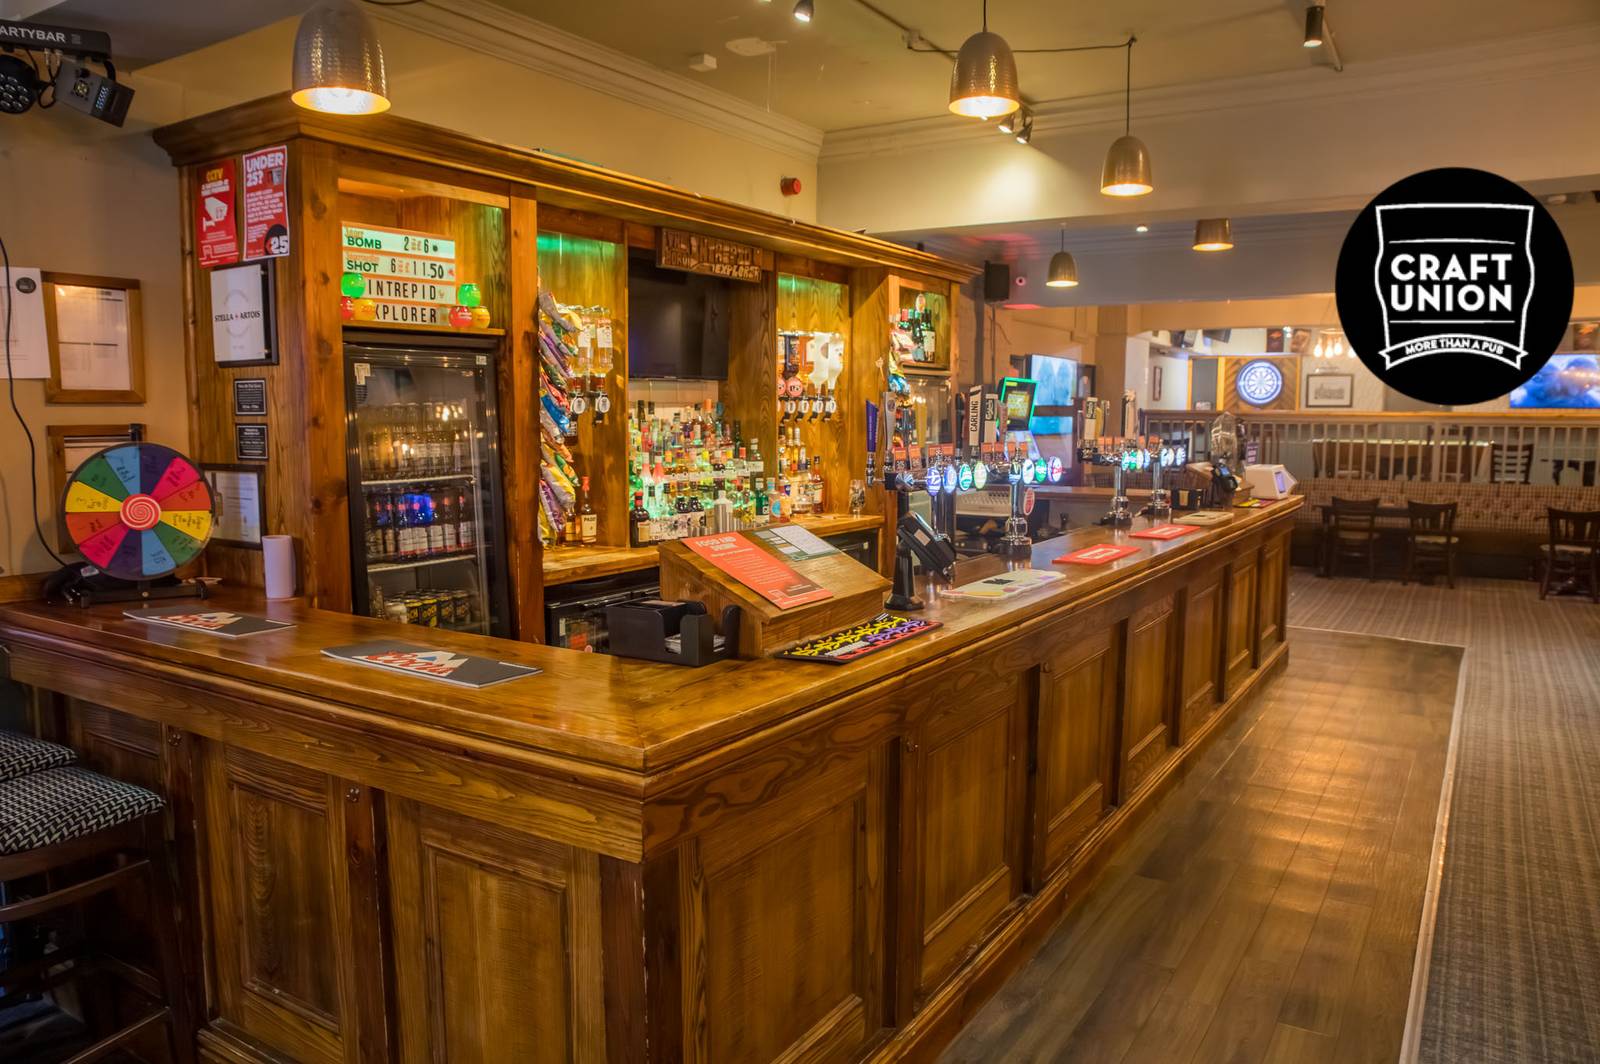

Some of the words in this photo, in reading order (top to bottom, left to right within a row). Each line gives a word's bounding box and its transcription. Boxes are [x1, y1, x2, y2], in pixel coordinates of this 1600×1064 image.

[246, 152, 284, 172] UNDER
[246, 171, 264, 187] 25?
[271, 235, 289, 254] 25
[347, 236, 382, 250] BOMB
[403, 236, 410, 251] 2
[346, 260, 379, 273] SHOT
[390, 258, 396, 273] 6
[368, 279, 437, 300] INTREPID
[214, 313, 234, 322] STELLA
[239, 311, 261, 320] ARTOIS
[970, 400, 980, 432] CARLING
